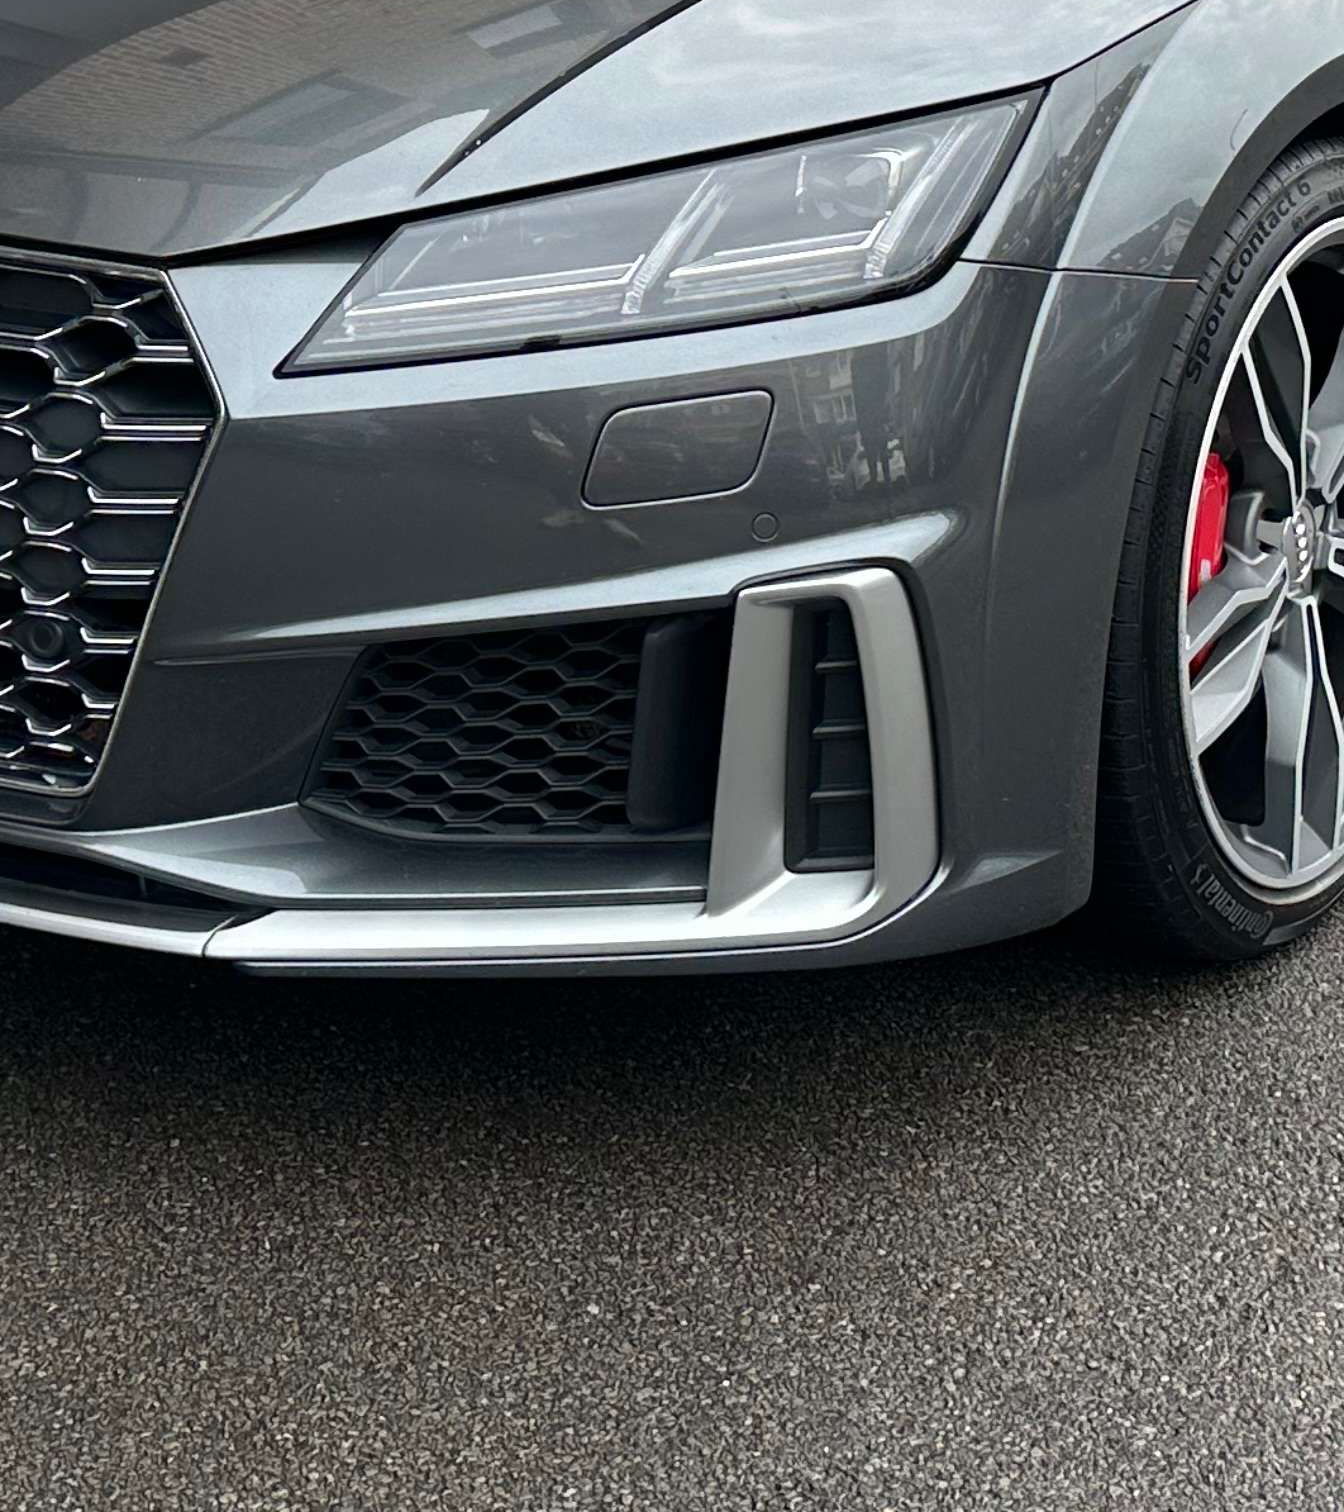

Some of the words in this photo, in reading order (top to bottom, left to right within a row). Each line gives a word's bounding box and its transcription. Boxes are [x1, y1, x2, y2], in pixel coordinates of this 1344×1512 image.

[1185, 189, 1297, 385] SportContact
[1297, 181, 1311, 196] 6
[1195, 873, 1274, 939] Continental
